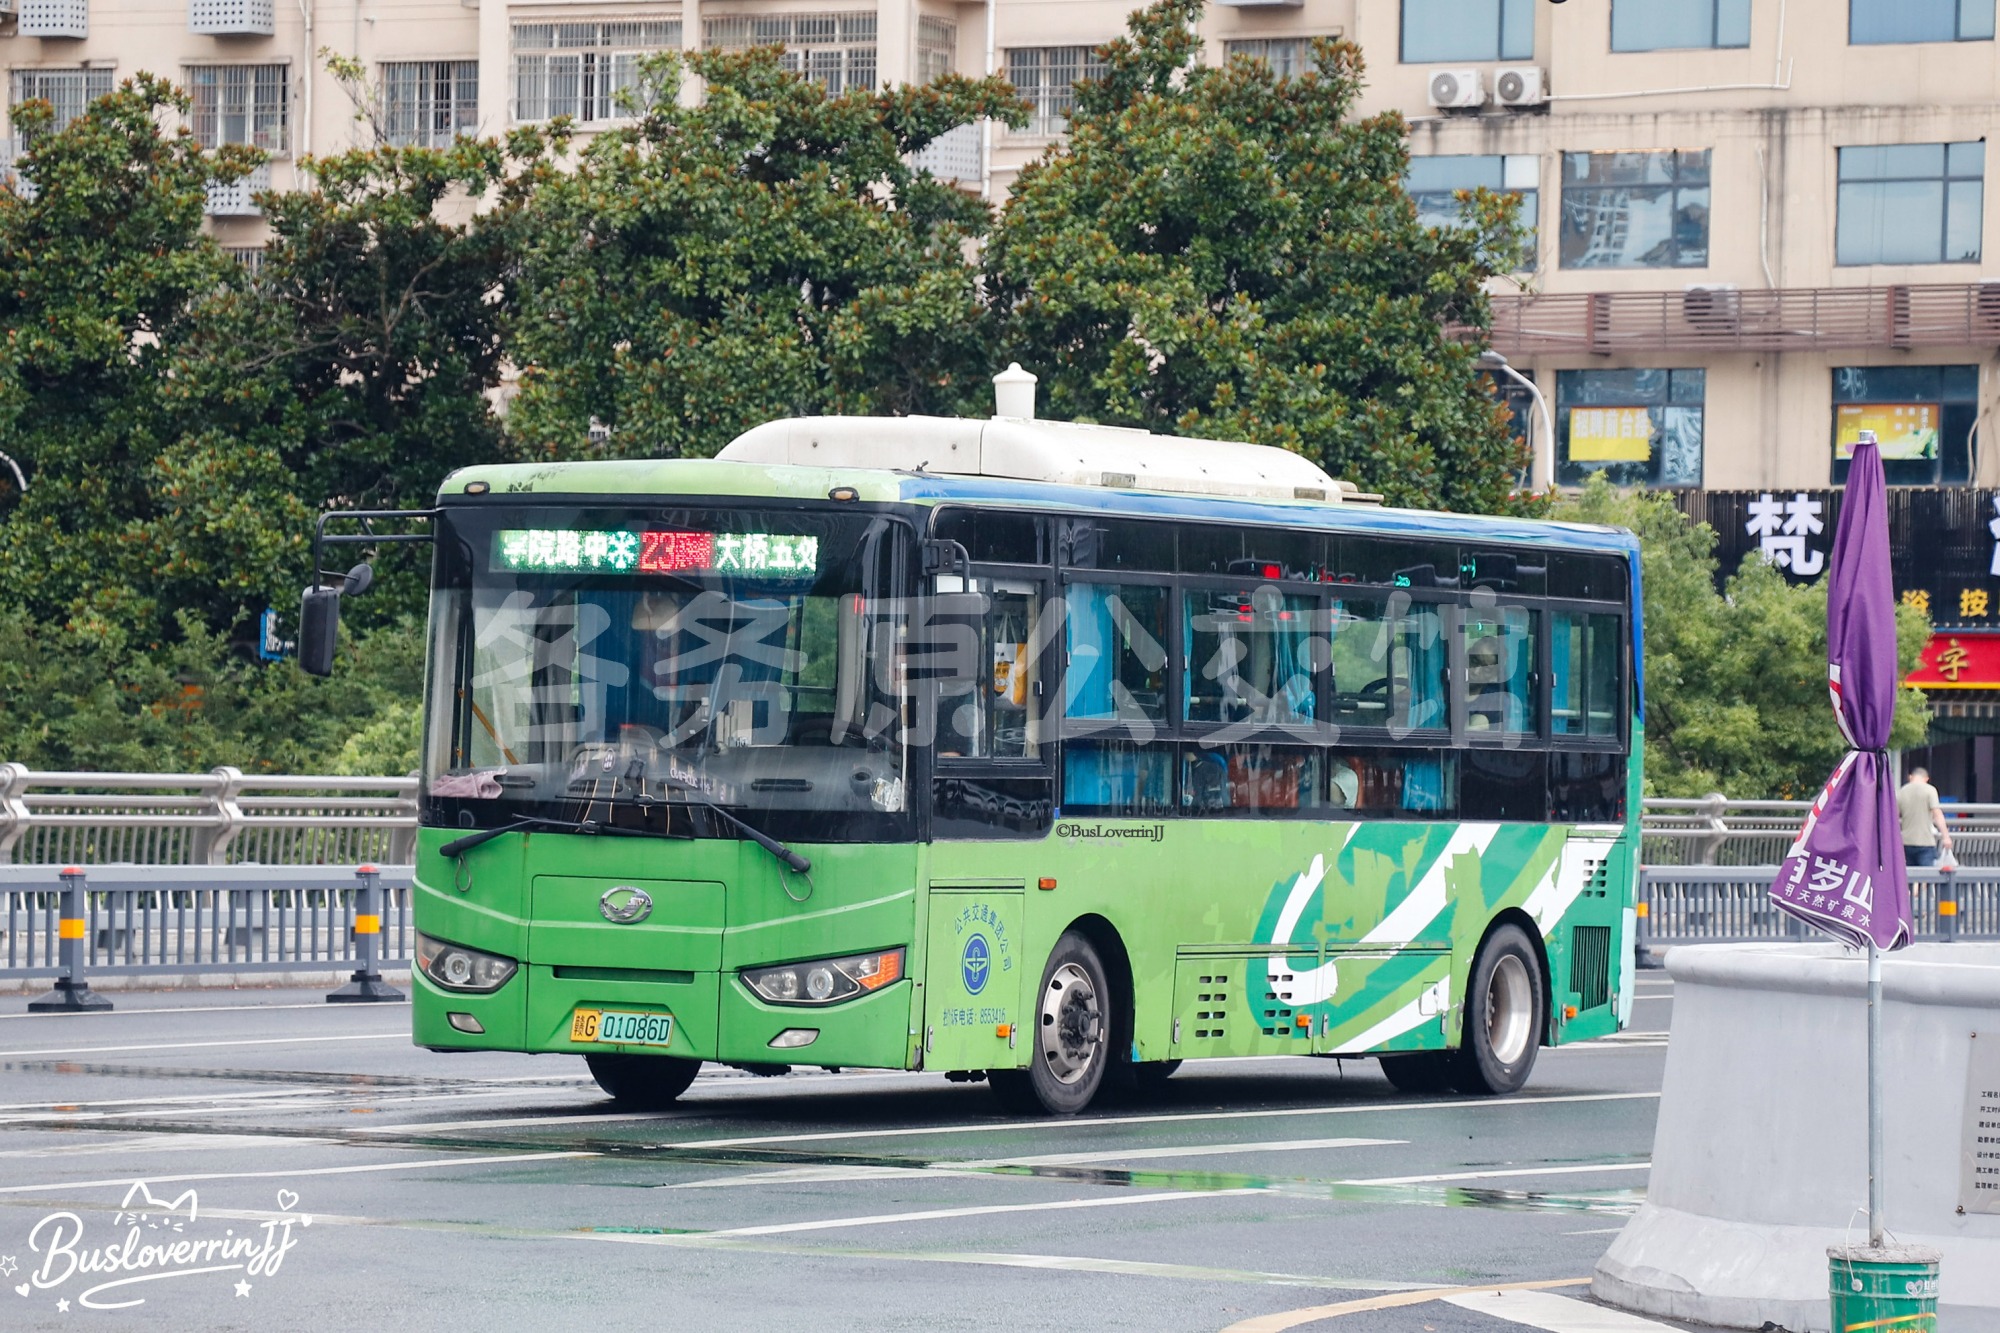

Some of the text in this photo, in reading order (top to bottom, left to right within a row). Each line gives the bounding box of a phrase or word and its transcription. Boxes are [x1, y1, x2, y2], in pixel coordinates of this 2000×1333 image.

[1745, 493, 1825, 576] 梵
[954, 902, 1012, 972] 公共交通集团公司
[1981, 1090, 2000, 1099] 工程名
